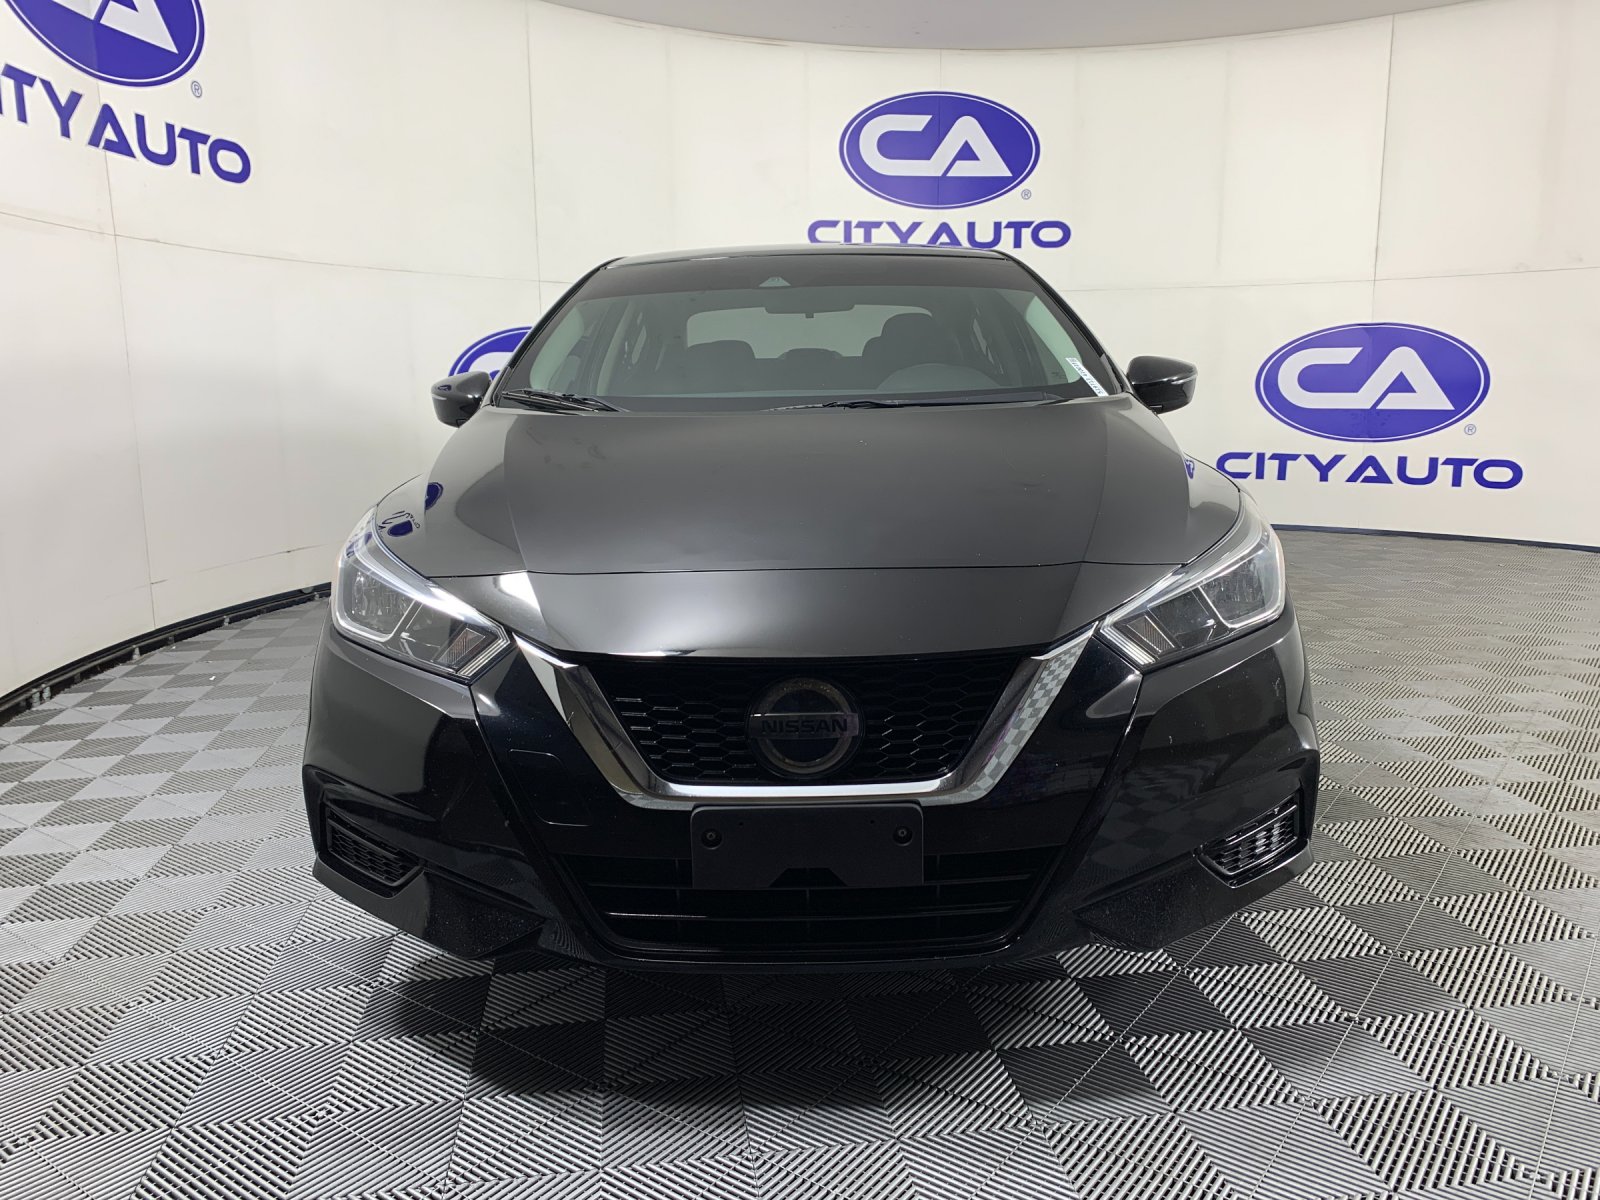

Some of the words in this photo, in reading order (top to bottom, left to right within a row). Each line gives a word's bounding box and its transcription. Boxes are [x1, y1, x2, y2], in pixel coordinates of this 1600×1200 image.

[859, 113, 1013, 177] CA
[1277, 346, 1456, 410] CA
[761, 718, 848, 733] NISSAN
